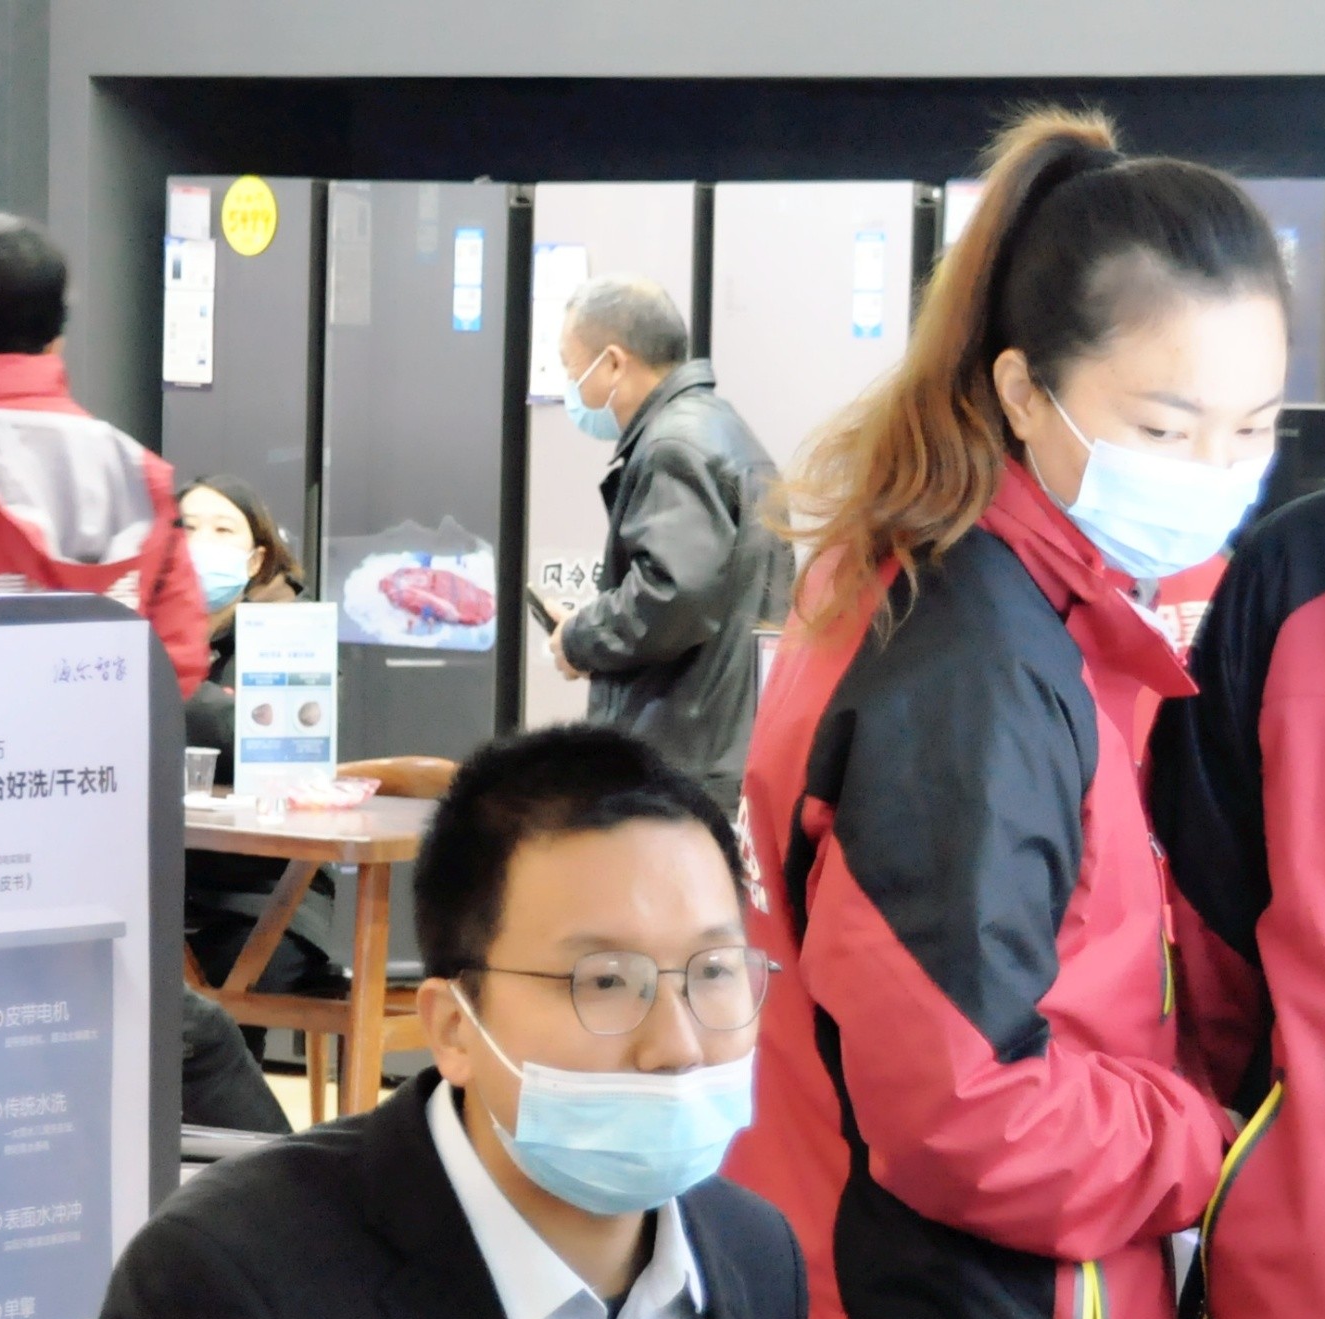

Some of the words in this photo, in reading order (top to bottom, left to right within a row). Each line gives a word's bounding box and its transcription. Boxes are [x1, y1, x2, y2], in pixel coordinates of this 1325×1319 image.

[5, 1000, 70, 1028] 皮带电机
[4, 1089, 67, 1119] 传统水洗
